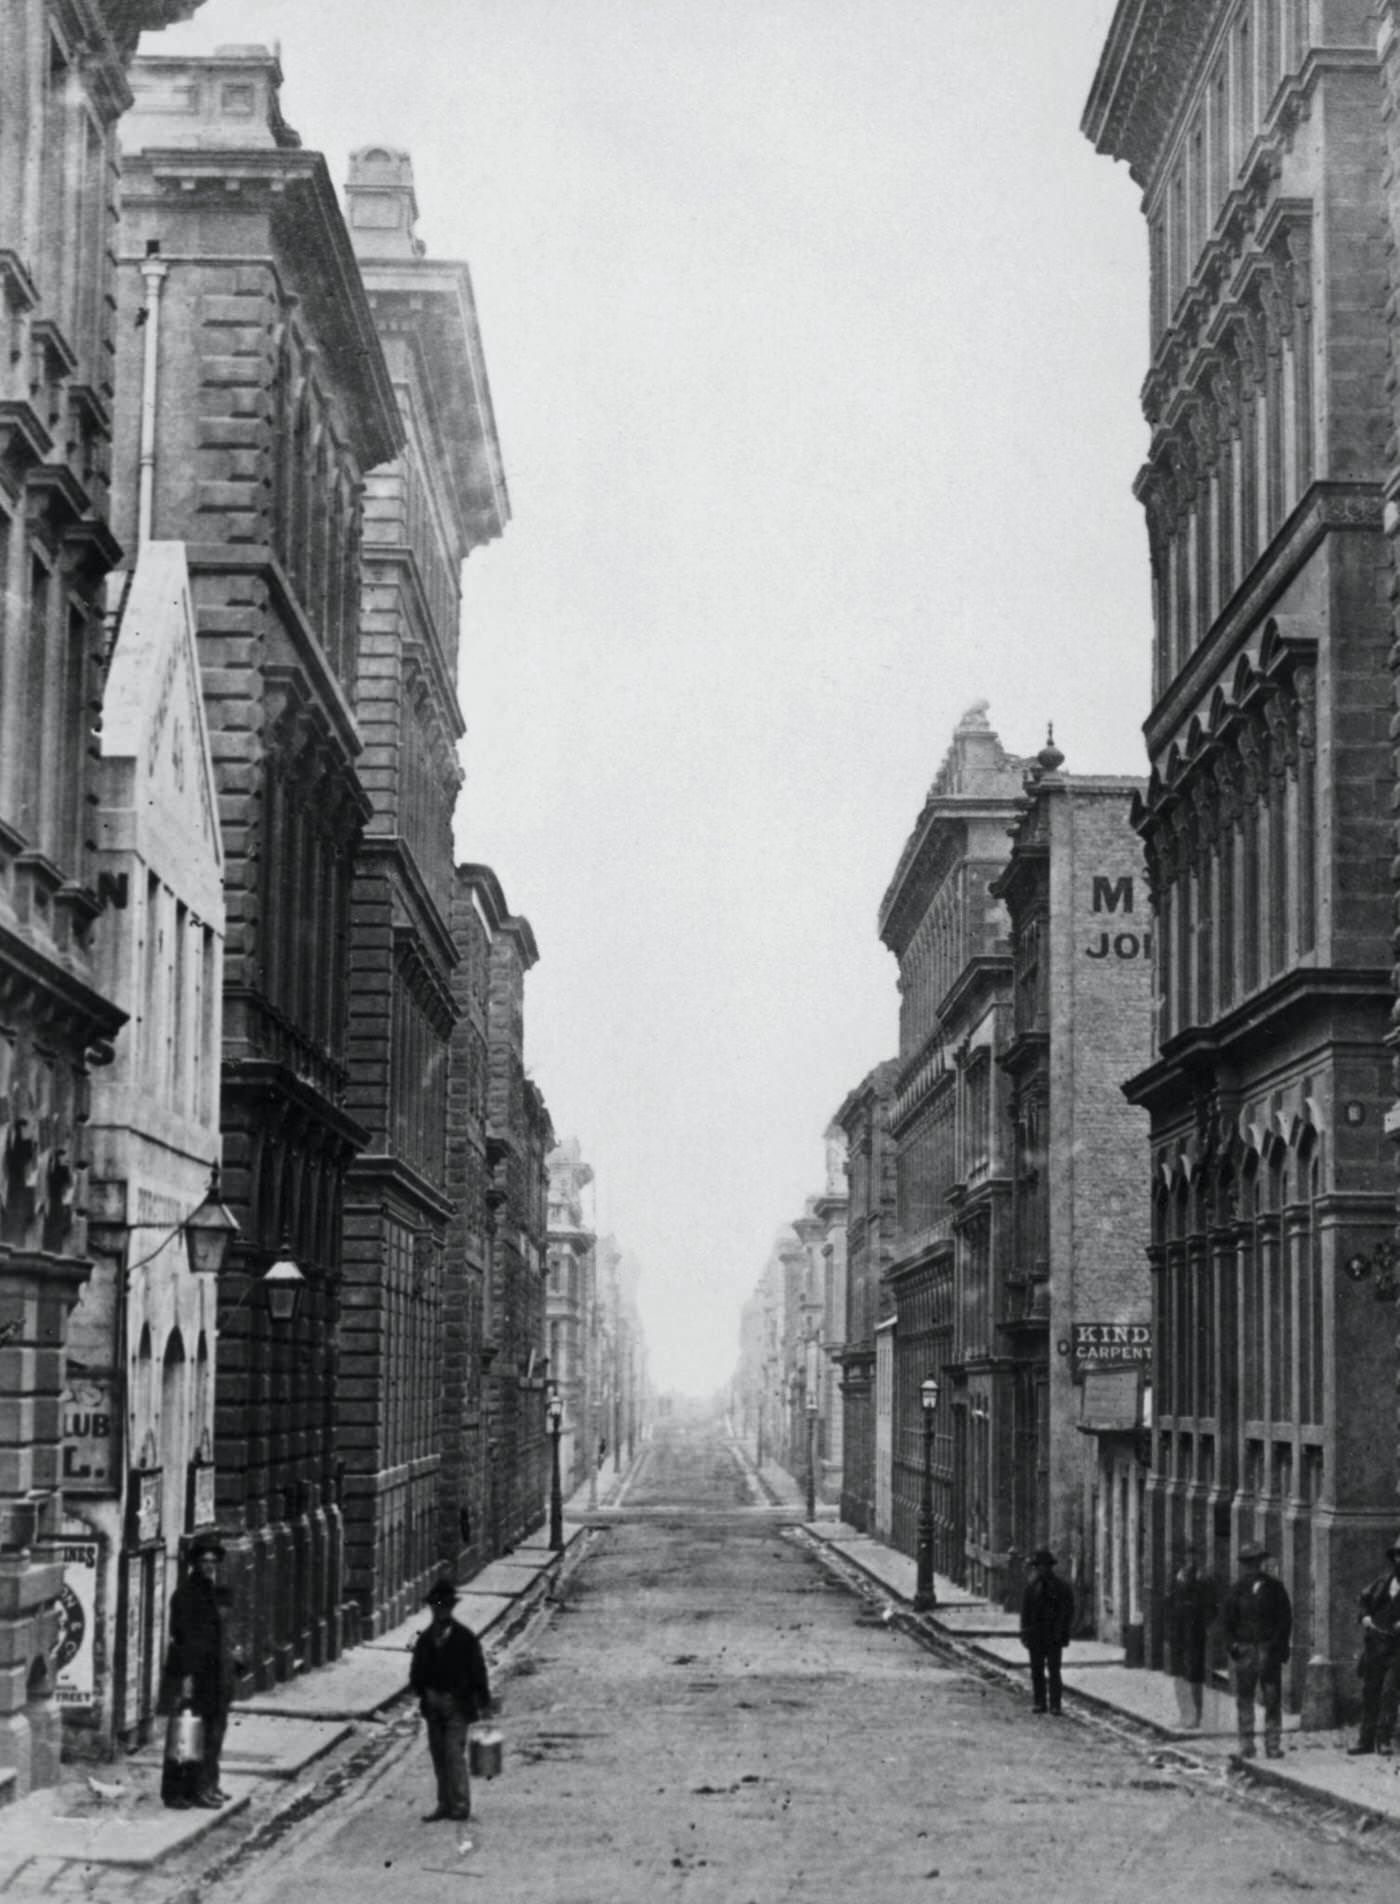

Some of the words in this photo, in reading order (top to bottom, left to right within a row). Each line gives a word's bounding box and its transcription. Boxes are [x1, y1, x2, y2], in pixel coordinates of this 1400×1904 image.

[1093, 876, 1133, 913] M
[1076, 1326, 1153, 1343] KIND
[1076, 1346, 1153, 1360] CARPENT
